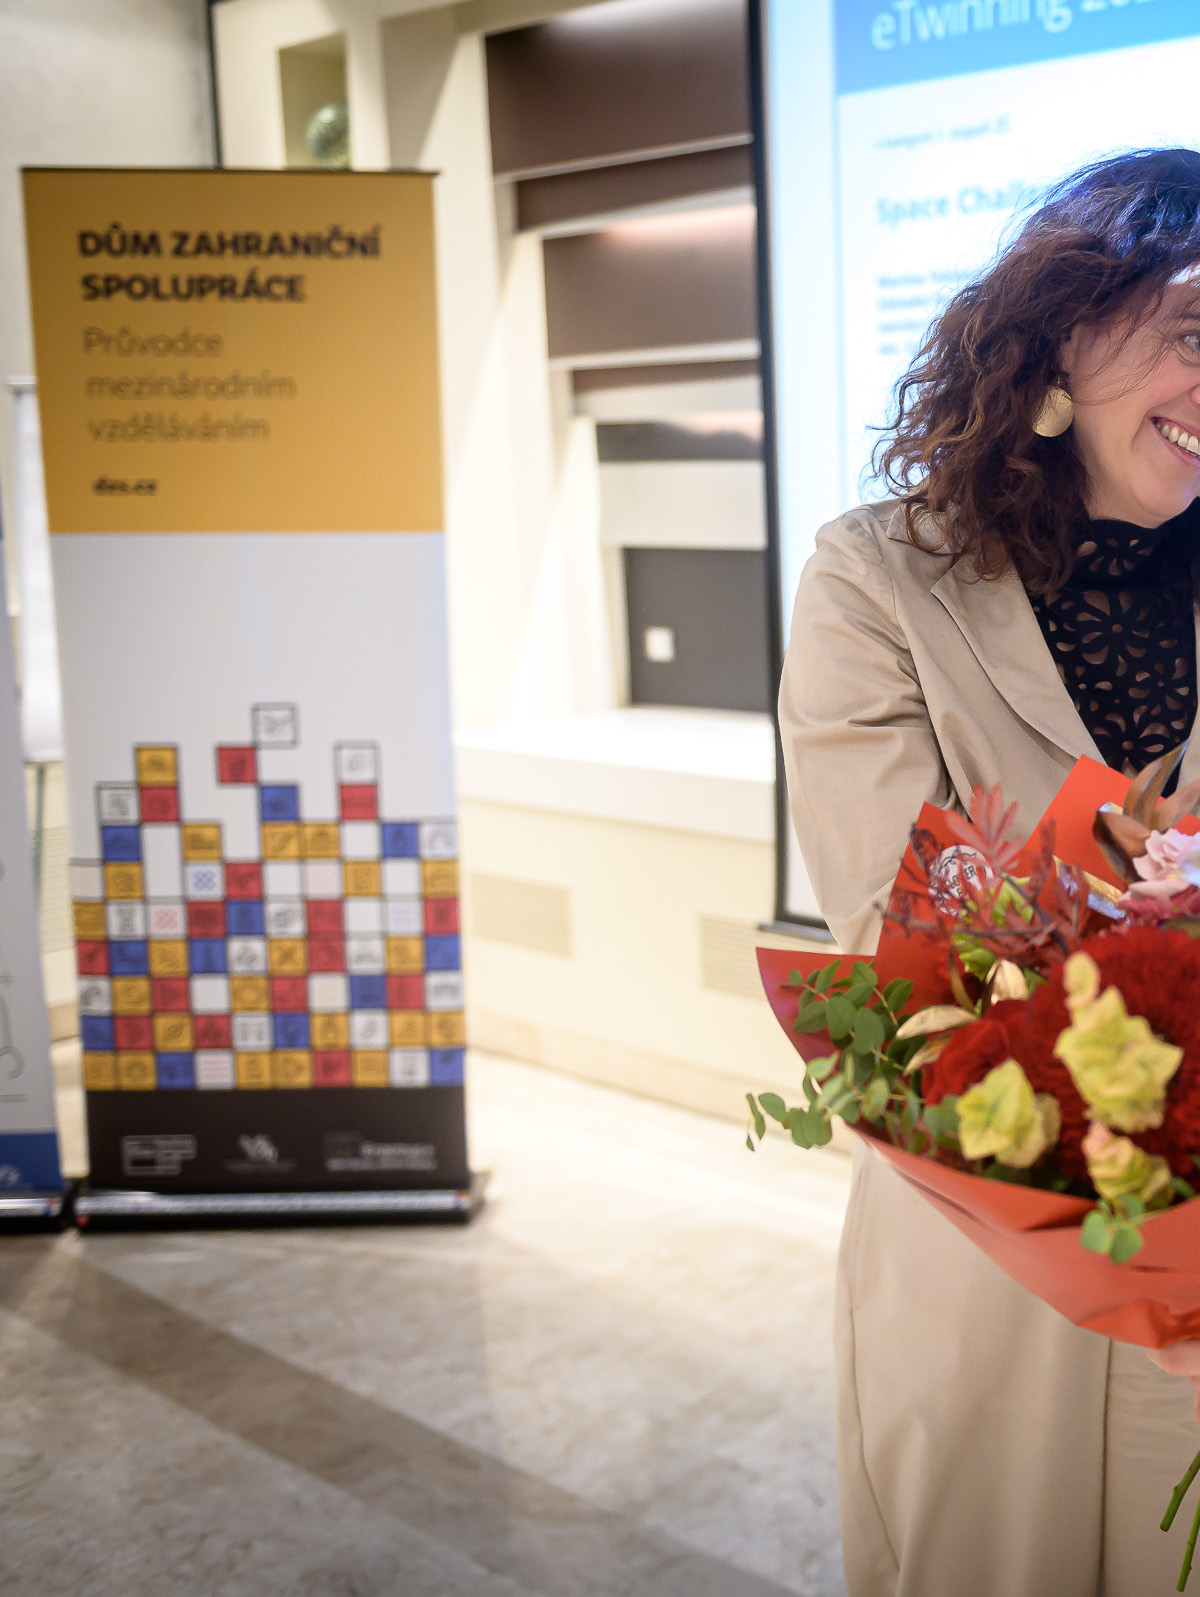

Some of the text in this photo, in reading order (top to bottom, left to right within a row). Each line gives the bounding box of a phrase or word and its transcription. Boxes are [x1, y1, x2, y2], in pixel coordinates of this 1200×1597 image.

[78, 221, 383, 260] DŮM ZAHRANIČNÍ
[81, 267, 308, 303] SPOLUPRÁCE
[83, 325, 225, 358] Průvodce
[86, 368, 299, 400] mezinárodním
[87, 410, 271, 443] vzděláváním
